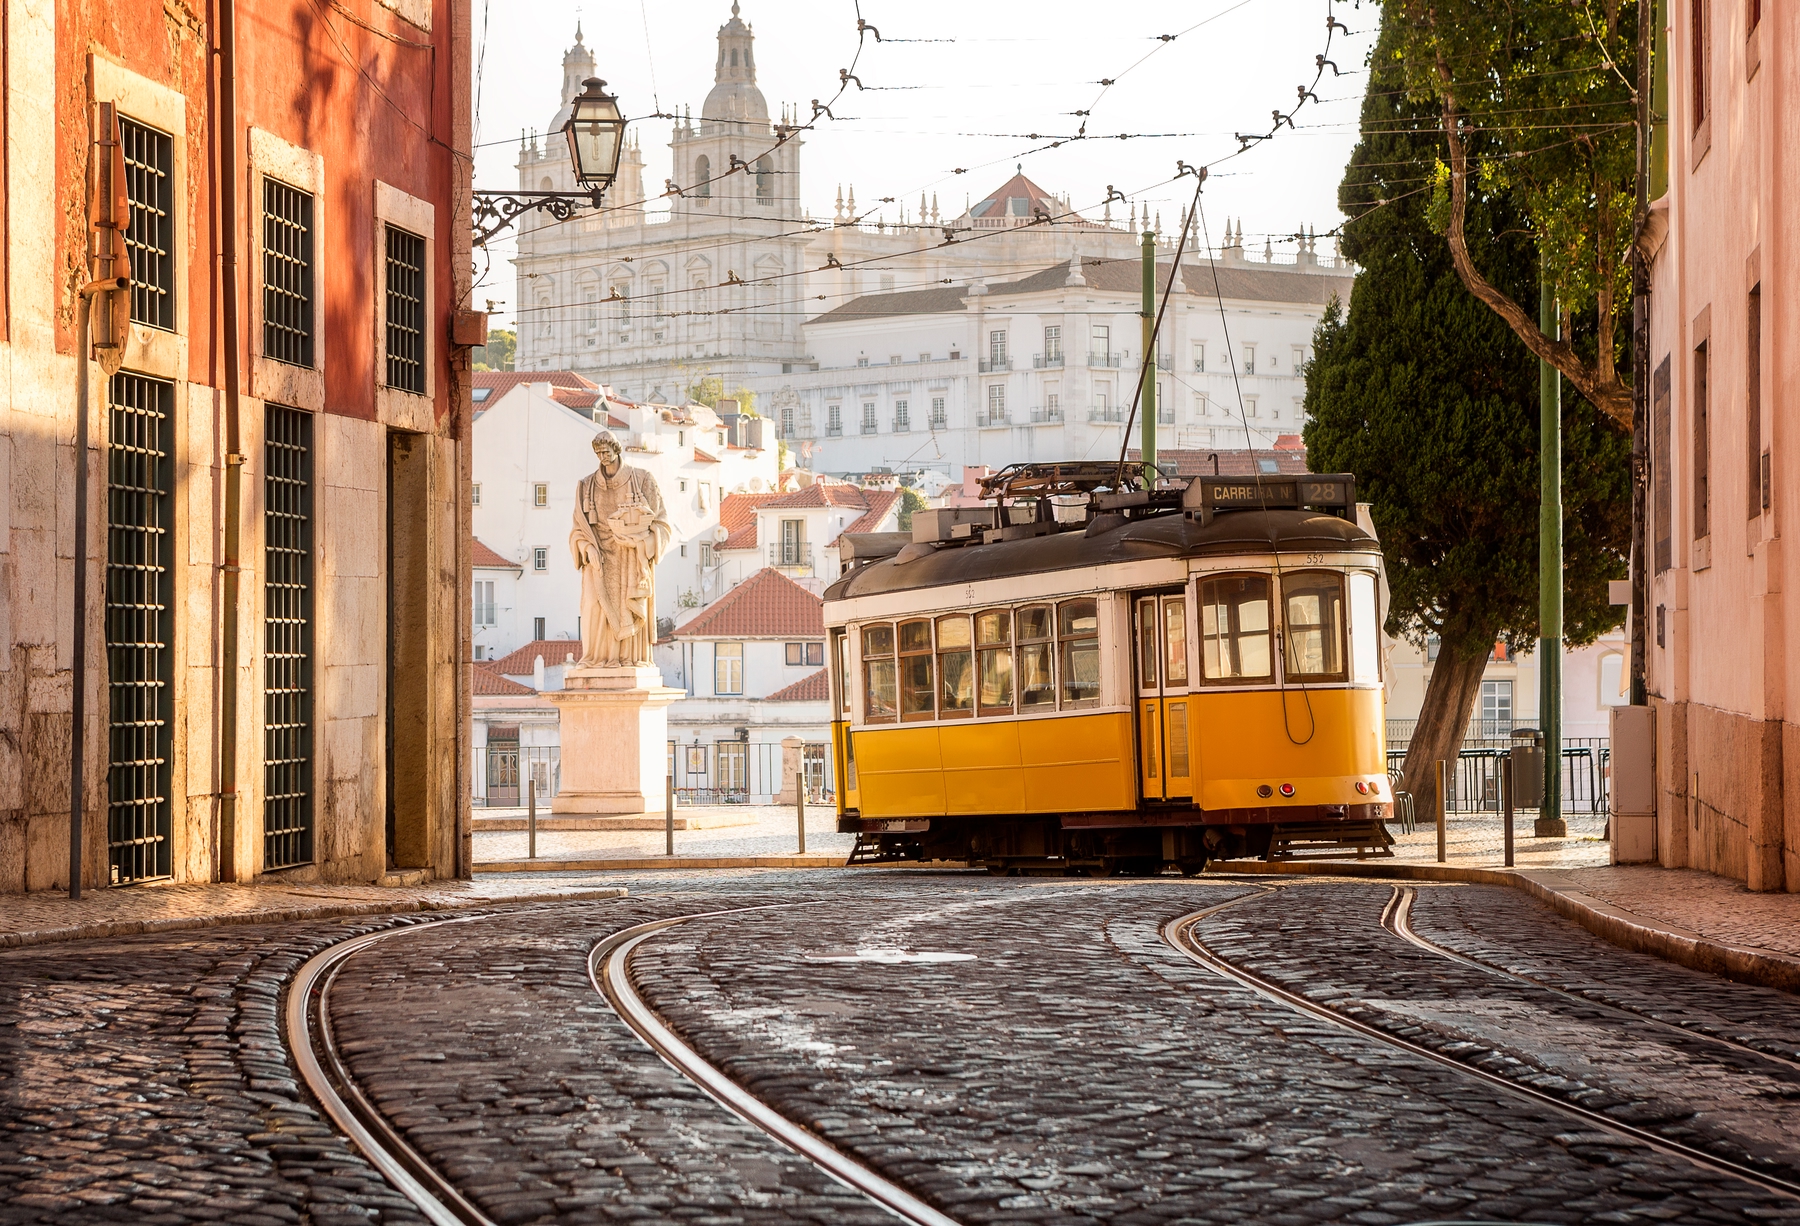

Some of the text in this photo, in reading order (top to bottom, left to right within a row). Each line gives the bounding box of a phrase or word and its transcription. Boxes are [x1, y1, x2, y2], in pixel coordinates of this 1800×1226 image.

[1213, 486, 1274, 500] CARREIRA
[1310, 483, 1336, 501] 28
[1306, 553, 1324, 564] 552
[965, 589, 975, 599] 552
